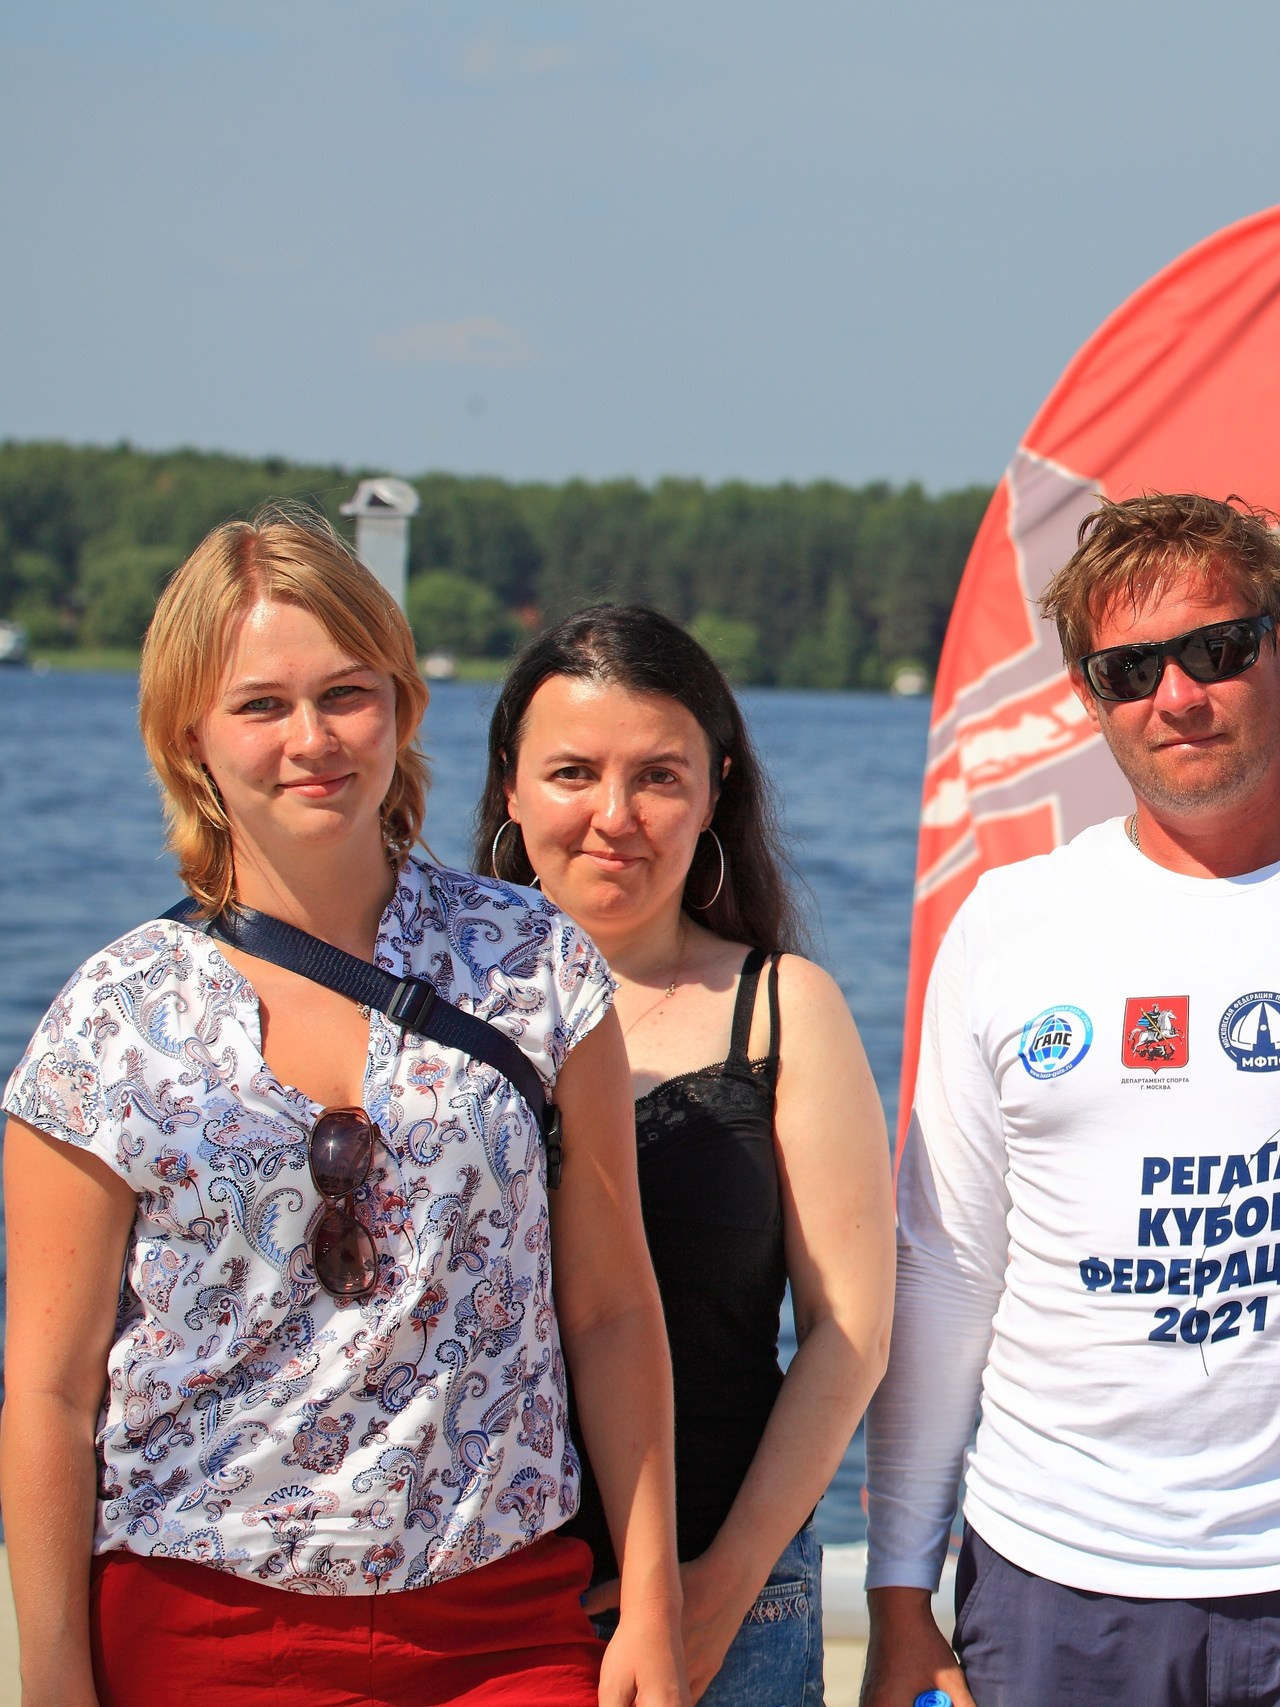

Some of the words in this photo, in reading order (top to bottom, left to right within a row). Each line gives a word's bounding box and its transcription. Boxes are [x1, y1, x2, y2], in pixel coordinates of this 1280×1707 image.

[1034, 1032, 1072, 1051] ГАЛС
[1220, 1008, 1235, 1049] МОСКОВСКАЯ
[1233, 992, 1274, 1009] ФЕДЕРАЦИЯ
[1148, 1295, 1269, 1345] 2021
